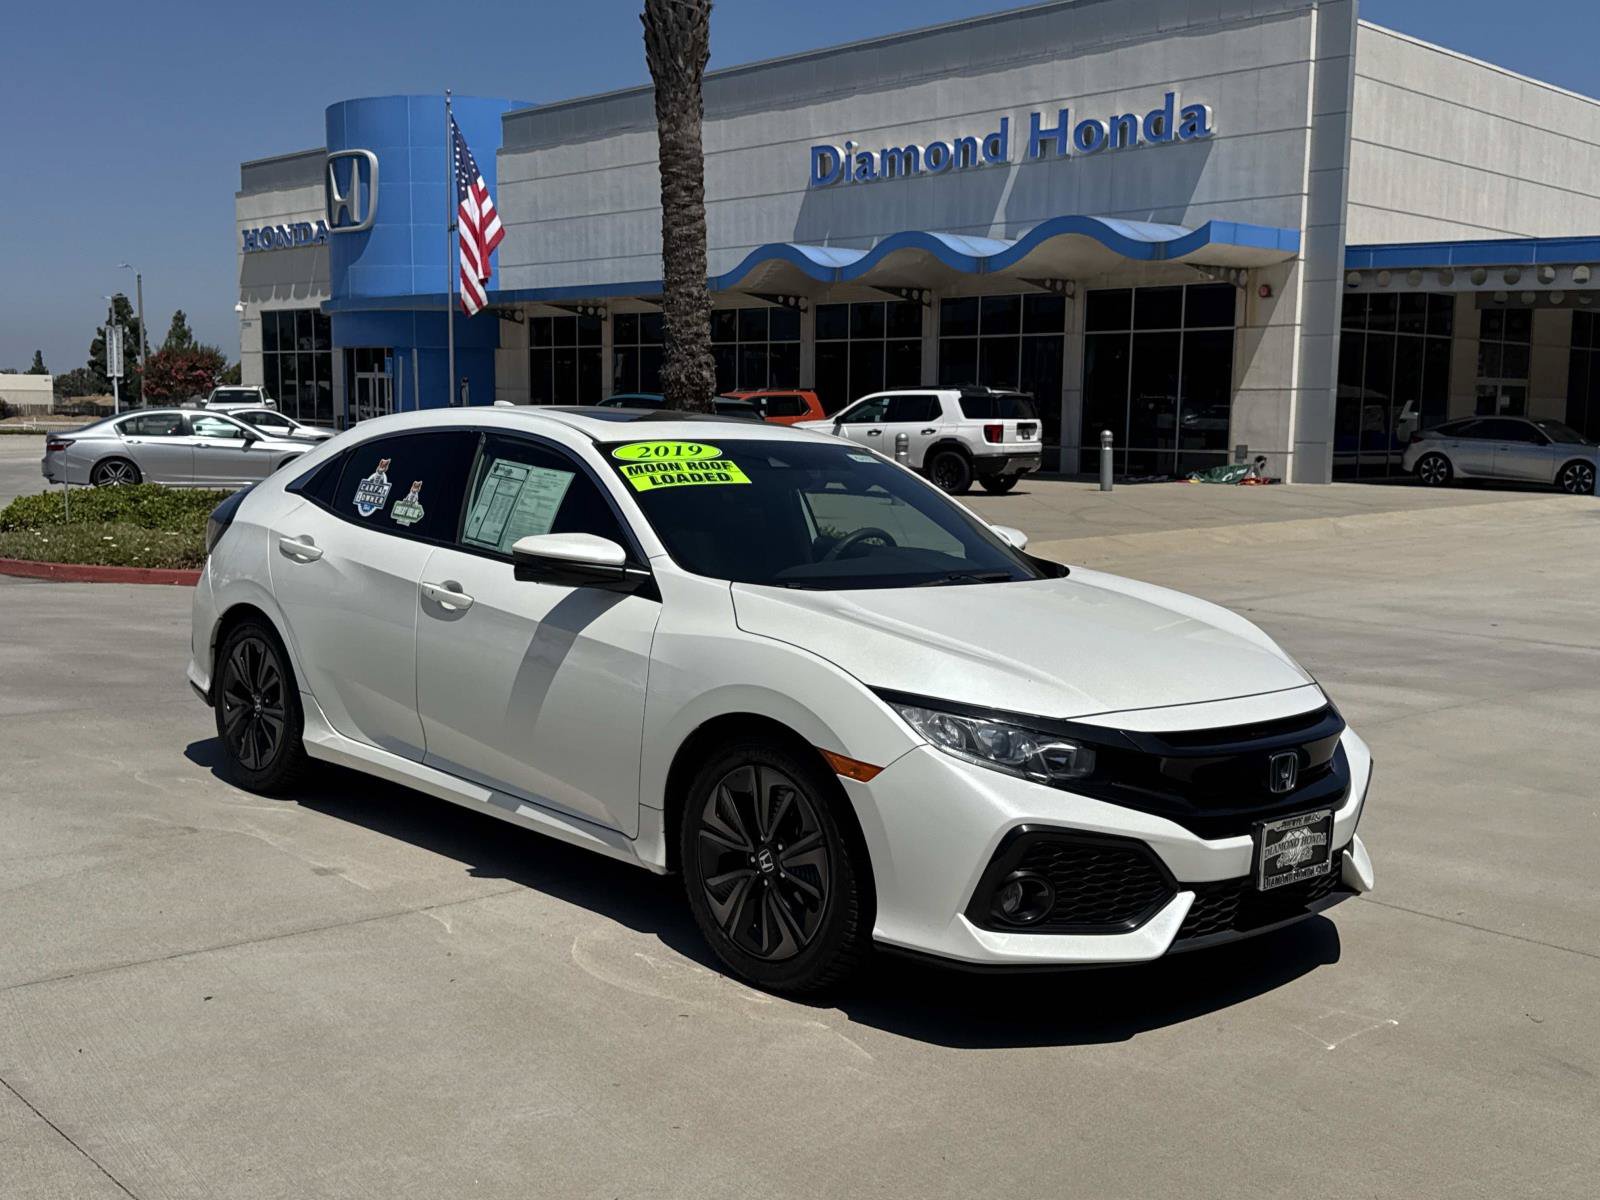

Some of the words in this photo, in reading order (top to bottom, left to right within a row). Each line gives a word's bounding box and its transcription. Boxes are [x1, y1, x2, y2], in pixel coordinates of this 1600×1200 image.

[810, 116, 1012, 188] Diamond
[1029, 91, 1213, 159] Honda
[241, 219, 330, 252] HONDA
[637, 445, 703, 459] 2019
[626, 462, 684, 476] MOON
[685, 461, 733, 472] ROOF
[648, 472, 734, 486] LOADED
[1264, 838, 1300, 859] DIAMOND
[1301, 833, 1327, 847] HONDA
